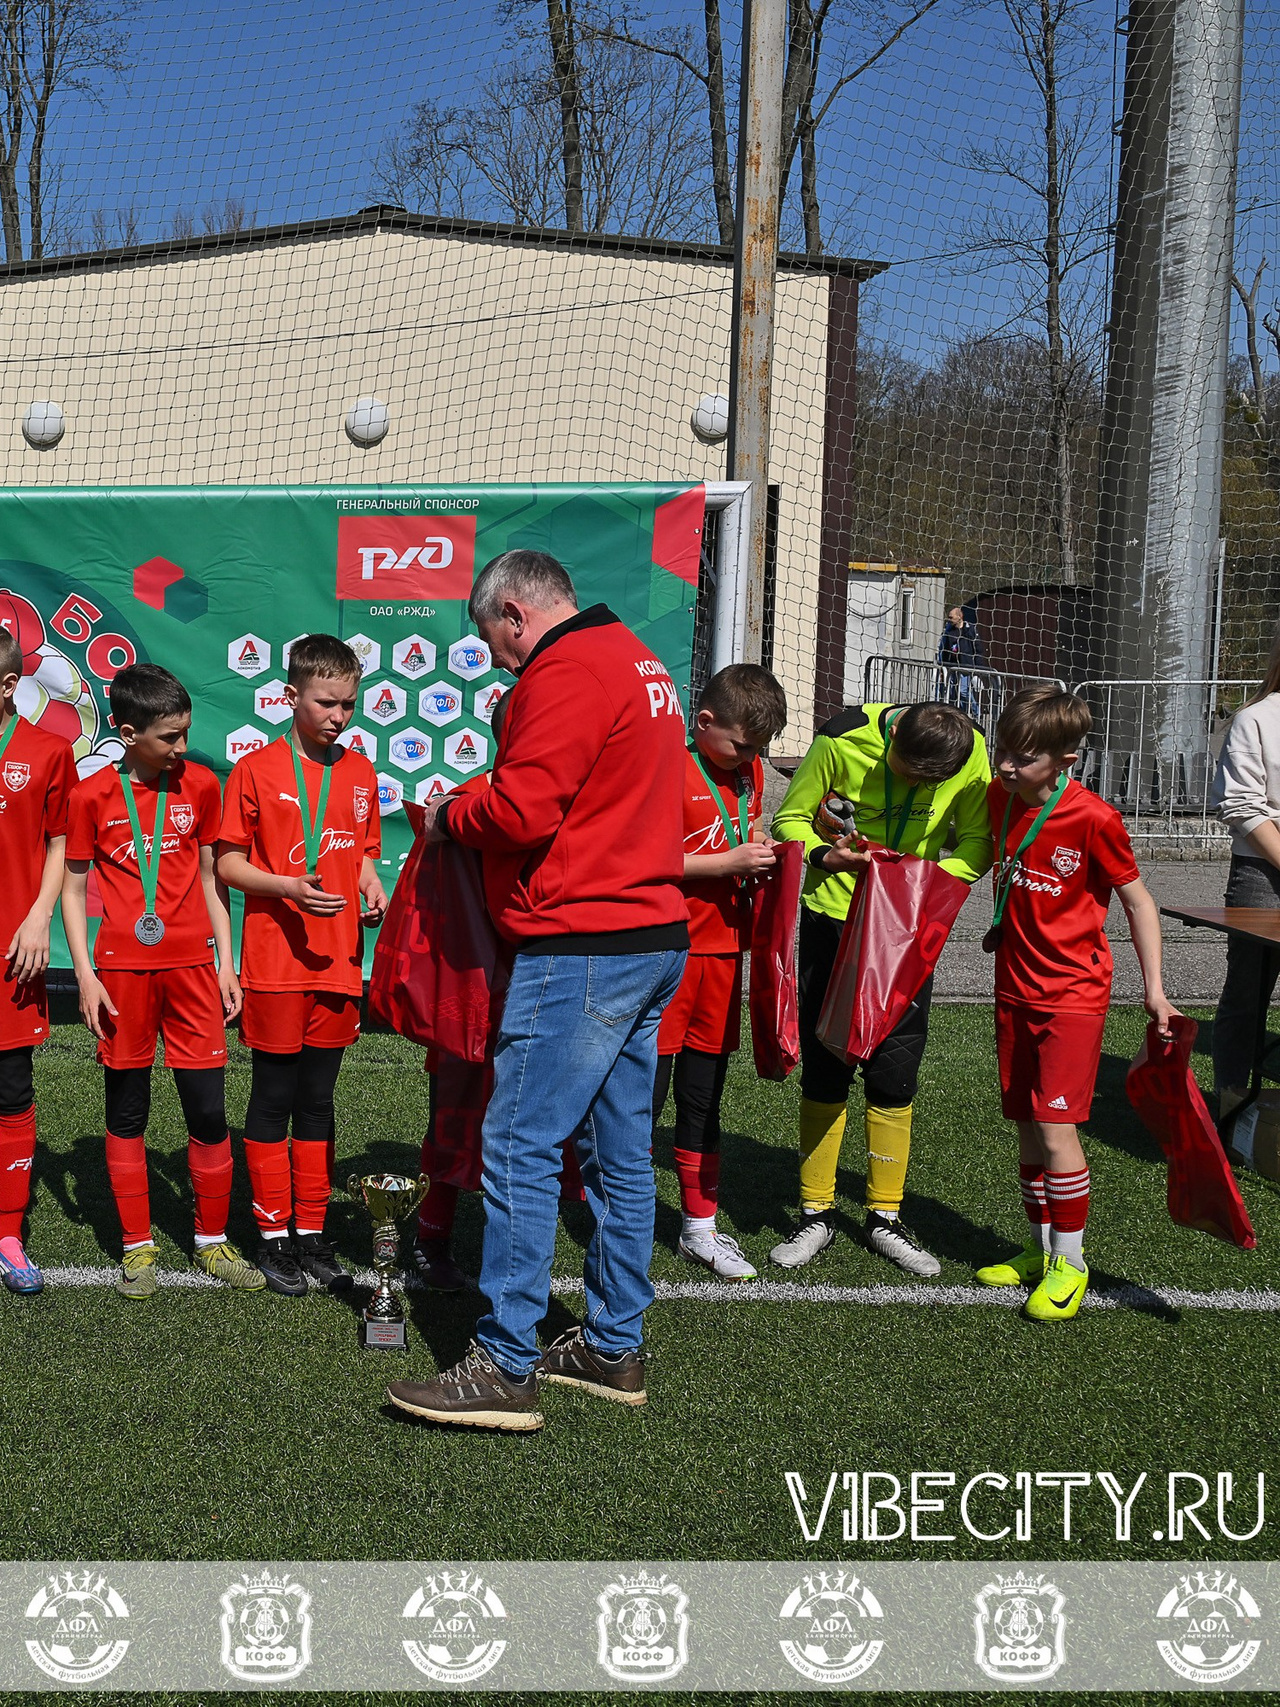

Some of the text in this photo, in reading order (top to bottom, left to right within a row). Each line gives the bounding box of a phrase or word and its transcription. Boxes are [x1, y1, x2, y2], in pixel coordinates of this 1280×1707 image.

[336, 497, 480, 510] ГЕНЕРАЛЬНЫЙ СПОНСОР
[369, 606, 436, 617] ОАО «РЖД»
